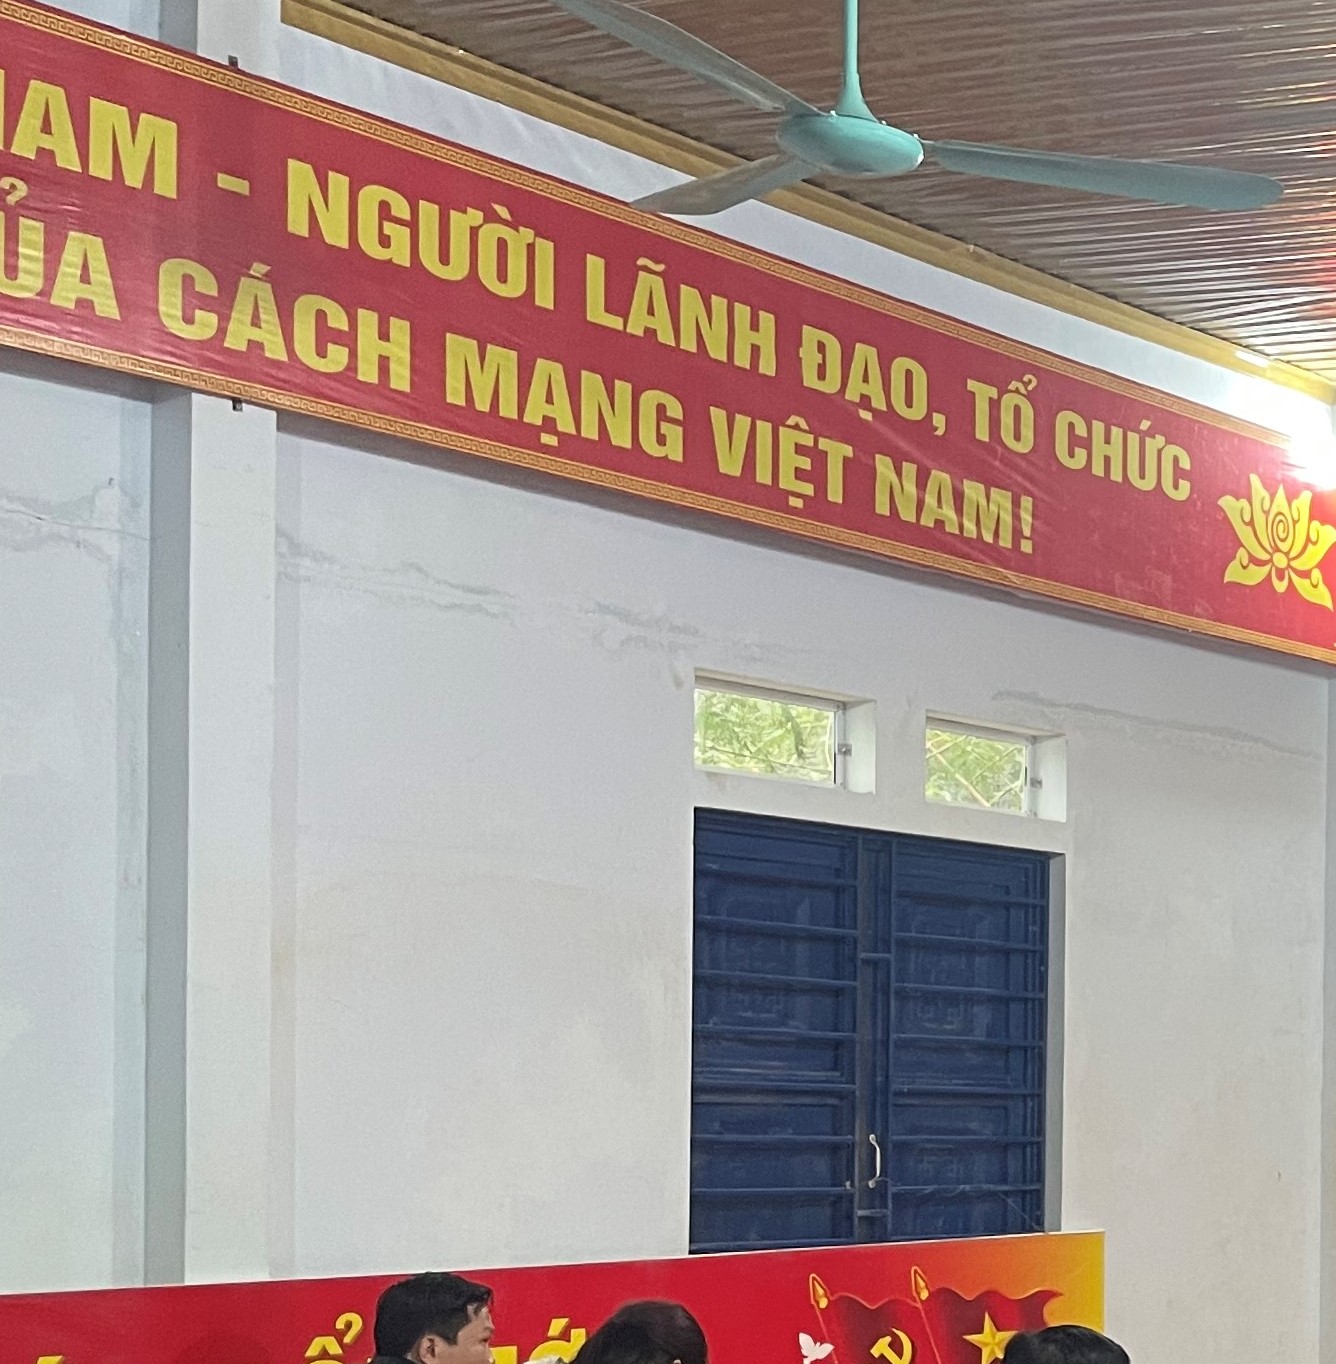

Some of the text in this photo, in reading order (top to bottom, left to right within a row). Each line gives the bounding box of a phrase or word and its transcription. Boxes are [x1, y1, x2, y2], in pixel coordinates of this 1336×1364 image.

[157, 259, 411, 394] CÁCH
[446, 332, 684, 464] MẠNG
[710, 407, 853, 508] VIỆT
[874, 454, 1033, 554] NAM!
[287, 158, 555, 311] NGƯỜI
[585, 253, 776, 377] LÃNH
[800, 325, 946, 437] ĐẠO,
[967, 374, 1035, 454] TỔ
[1055, 410, 1191, 501] CHỨC
